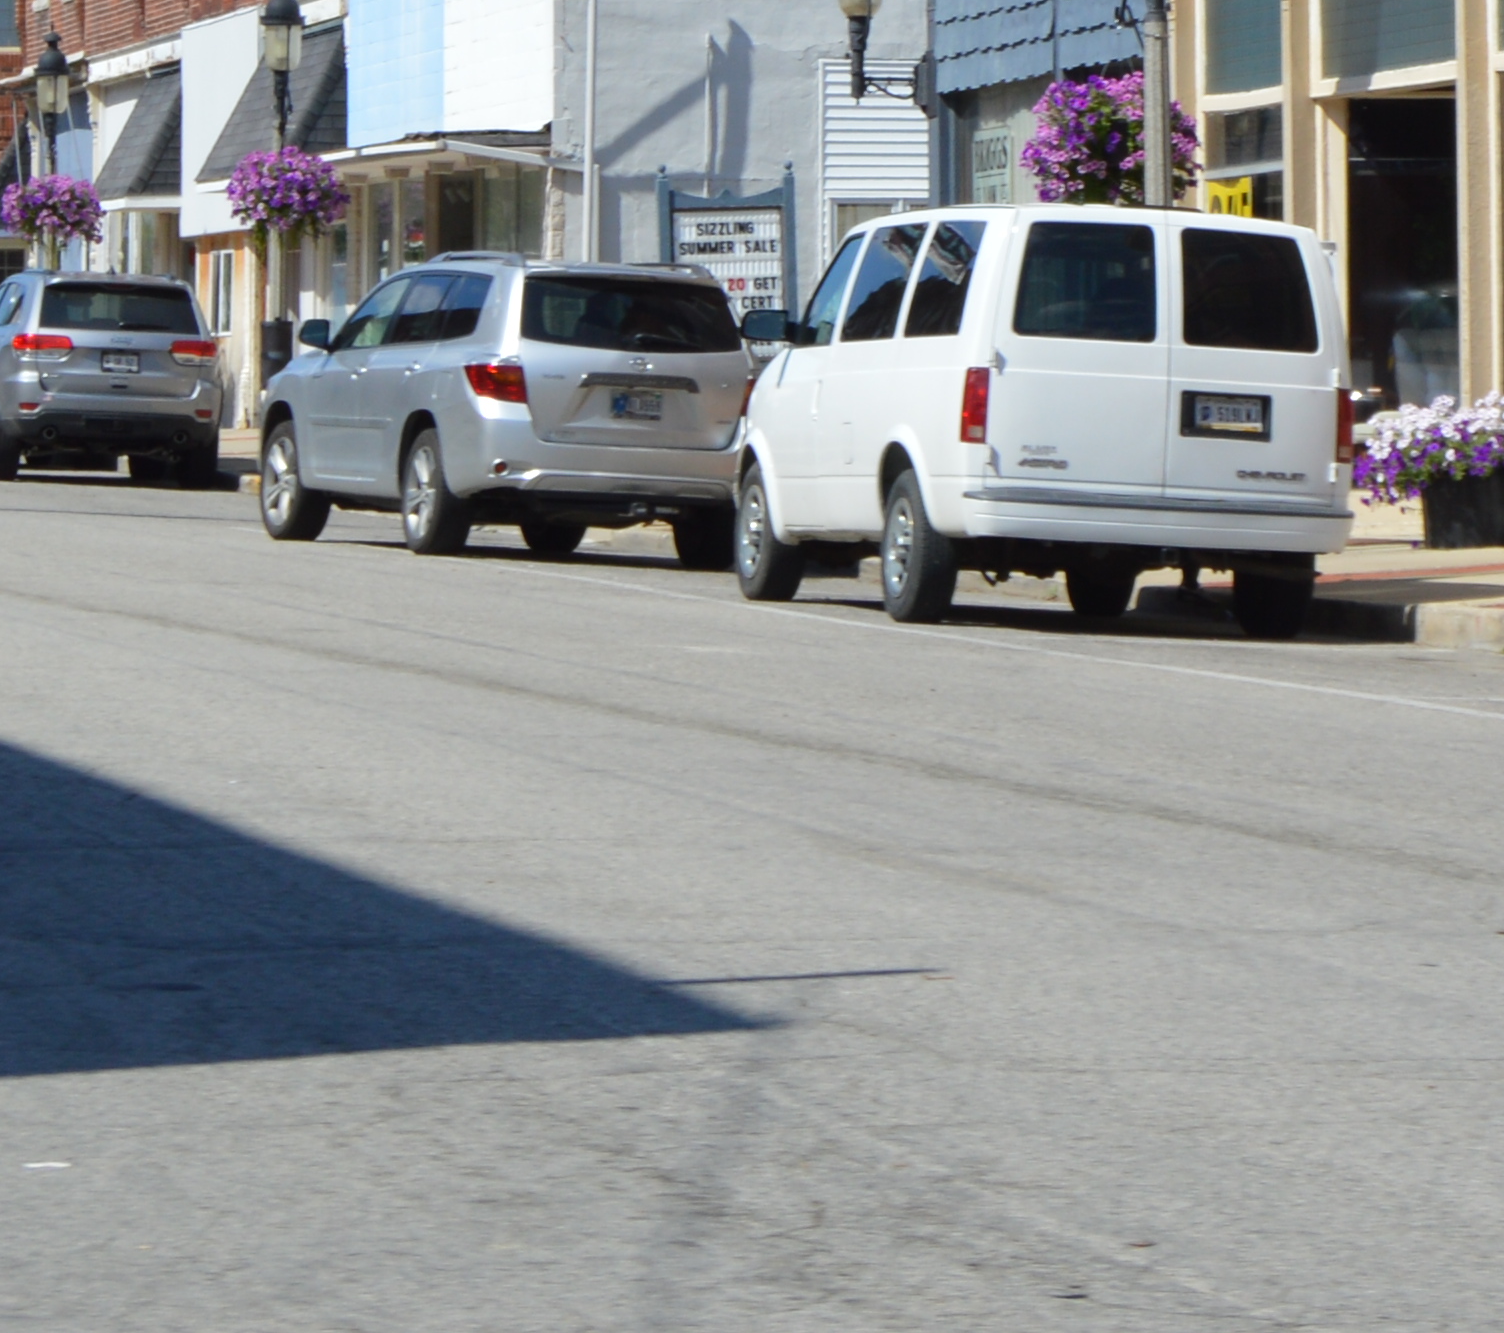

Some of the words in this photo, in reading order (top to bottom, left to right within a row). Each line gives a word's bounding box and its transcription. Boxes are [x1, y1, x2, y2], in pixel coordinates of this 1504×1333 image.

[696, 222, 755, 237] SIZZLING
[679, 240, 735, 256] SUMMER
[744, 239, 778, 253] SALE
[727, 278, 746, 292] 20
[753, 277, 778, 290] GET
[741, 295, 774, 310] CERT
